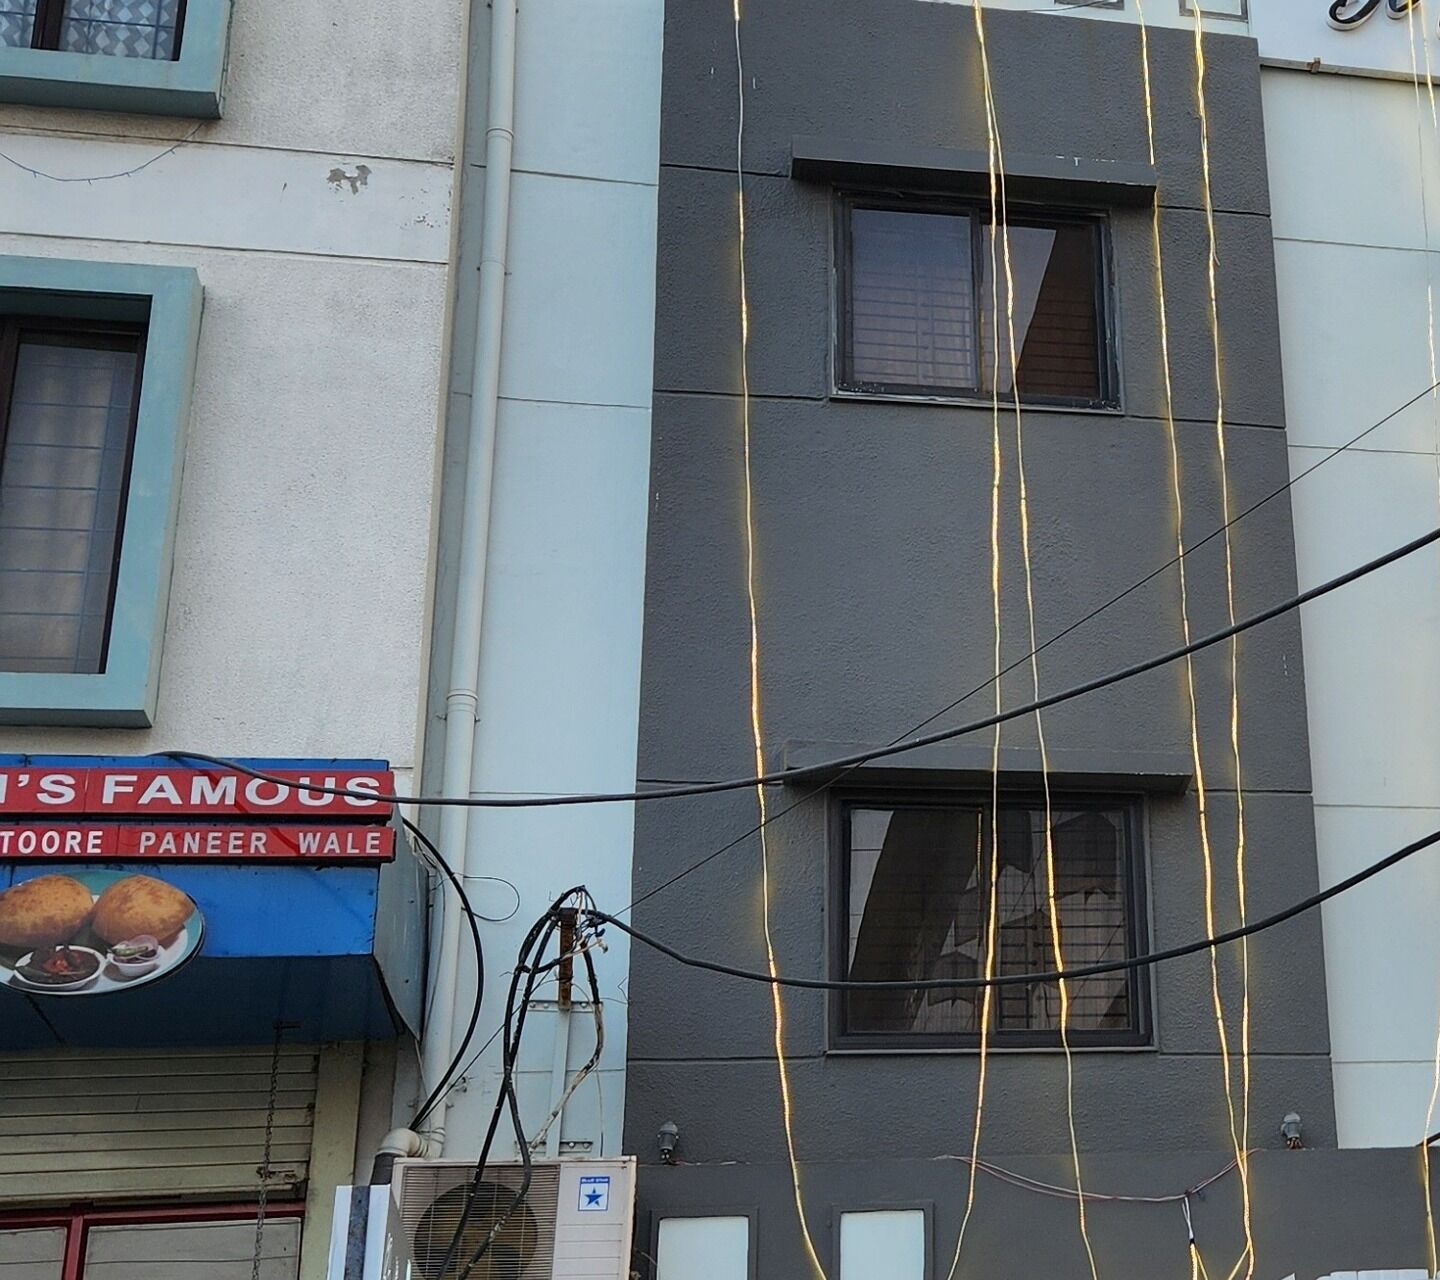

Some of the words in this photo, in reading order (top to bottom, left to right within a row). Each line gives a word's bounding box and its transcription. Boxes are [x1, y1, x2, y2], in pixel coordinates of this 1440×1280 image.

[102, 775, 380, 807] FAMOUS
[139, 831, 268, 855] PANEER
[298, 832, 382, 855] WALE
